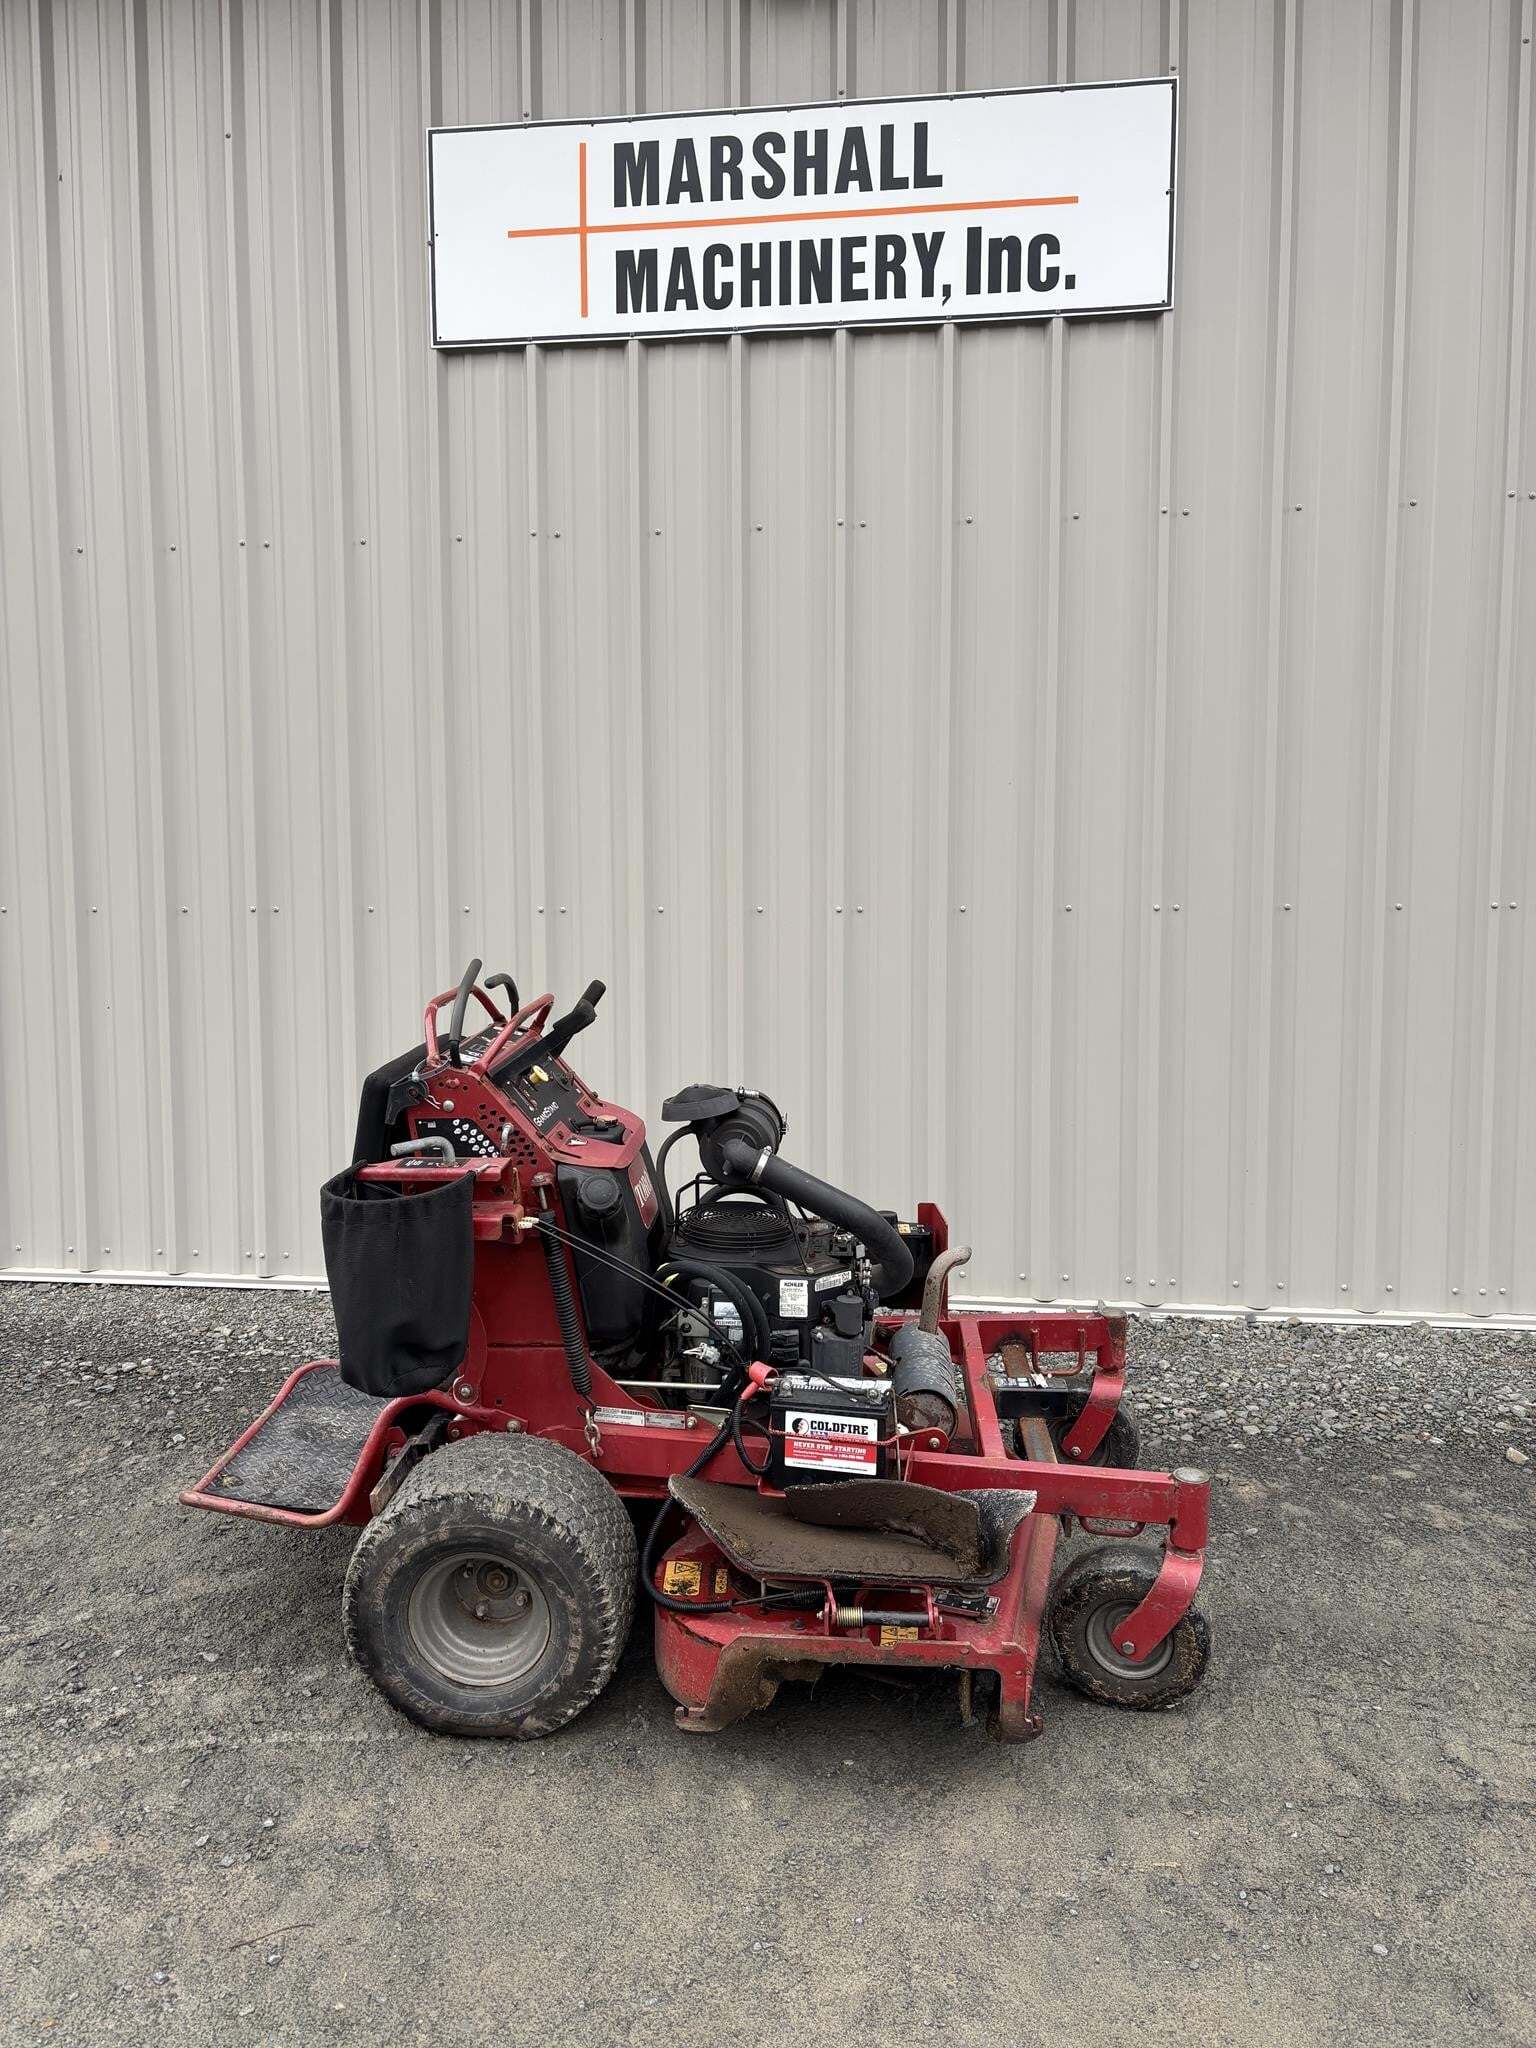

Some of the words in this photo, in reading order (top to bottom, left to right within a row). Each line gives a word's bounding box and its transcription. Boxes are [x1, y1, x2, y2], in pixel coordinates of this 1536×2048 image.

[613, 122, 943, 207] MARSHALL
[615, 231, 952, 314] MACHINERY,
[966, 226, 1076, 295] Inc.
[793, 1441, 815, 1449] NEVER
[816, 1443, 833, 1451] STOP
[834, 1445, 867, 1455] STARTING
[810, 1420, 869, 1435] COLDFIRE
